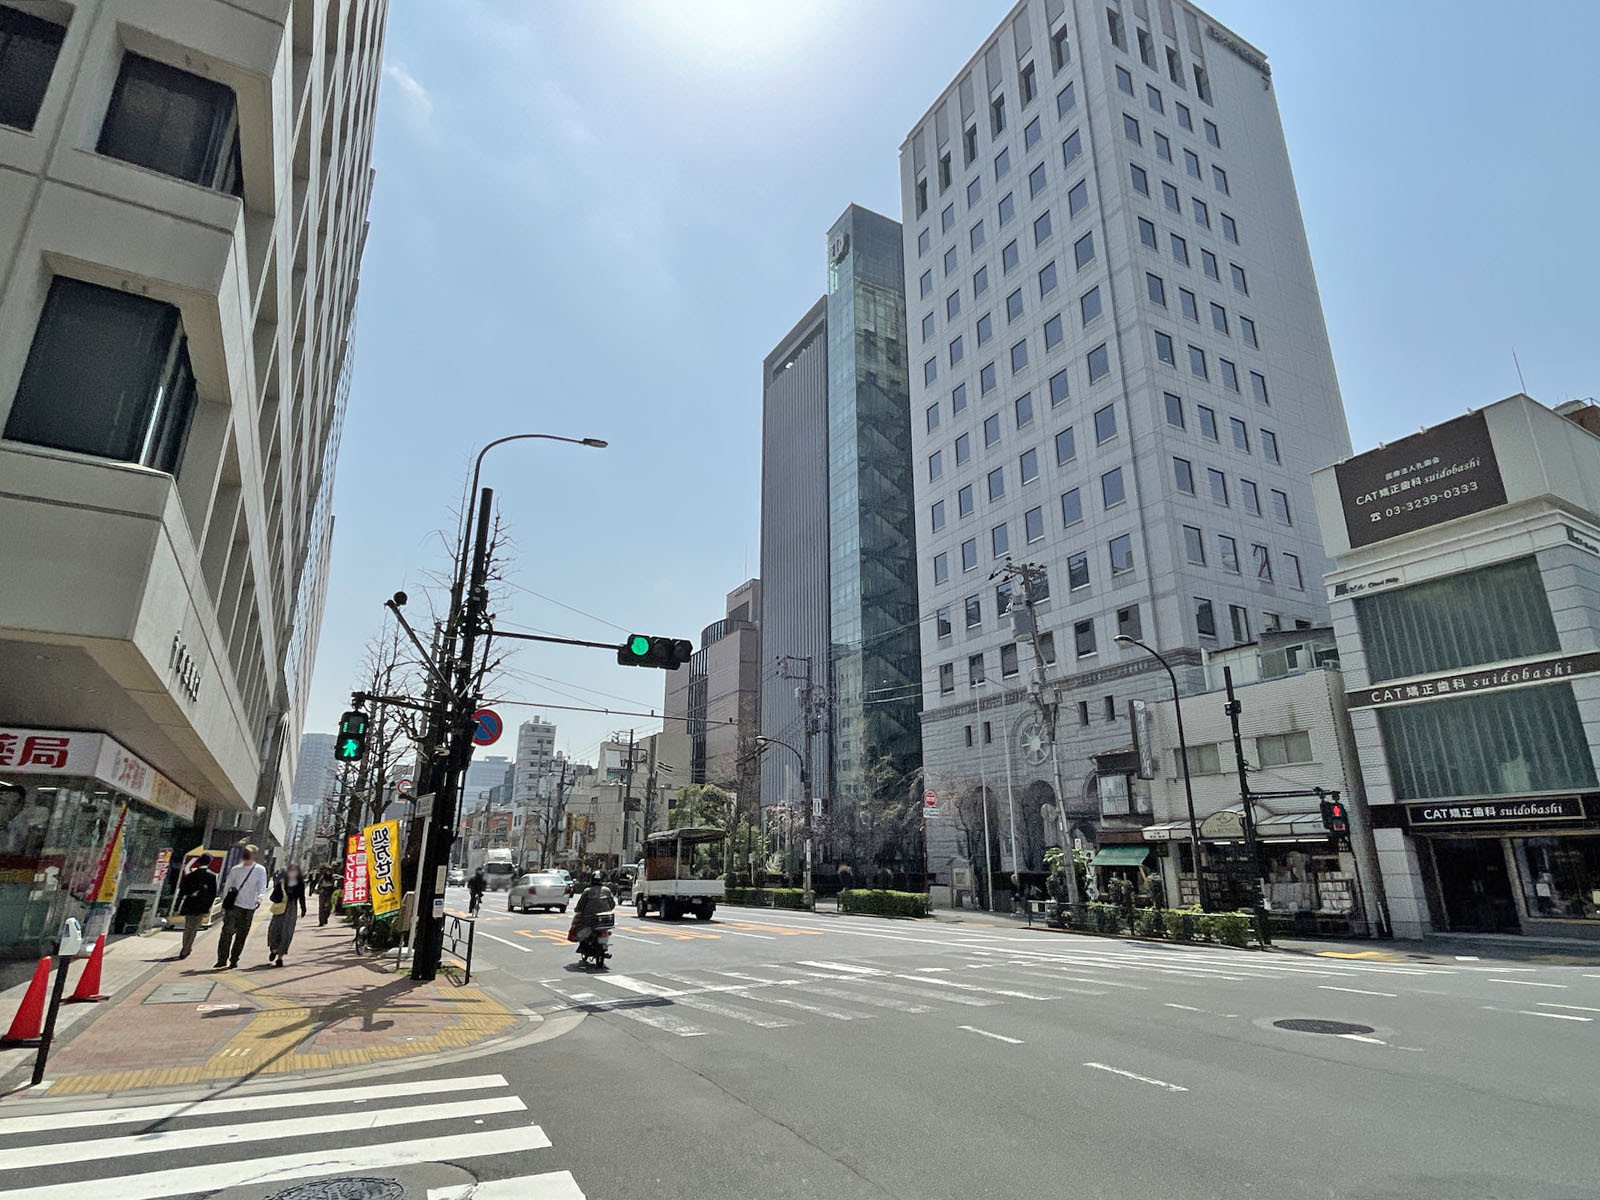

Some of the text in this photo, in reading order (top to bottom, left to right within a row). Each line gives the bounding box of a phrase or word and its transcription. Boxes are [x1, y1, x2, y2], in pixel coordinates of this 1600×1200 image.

[1356, 456, 1481, 505] CAT矯正歯科 suidobashi
[1385, 481, 1478, 517] 03-3239-0333
[1371, 662, 1572, 703] CAT矯正歯科 suidobashi
[1423, 802, 1563, 820] CAT矯正歯科 suidobashi
